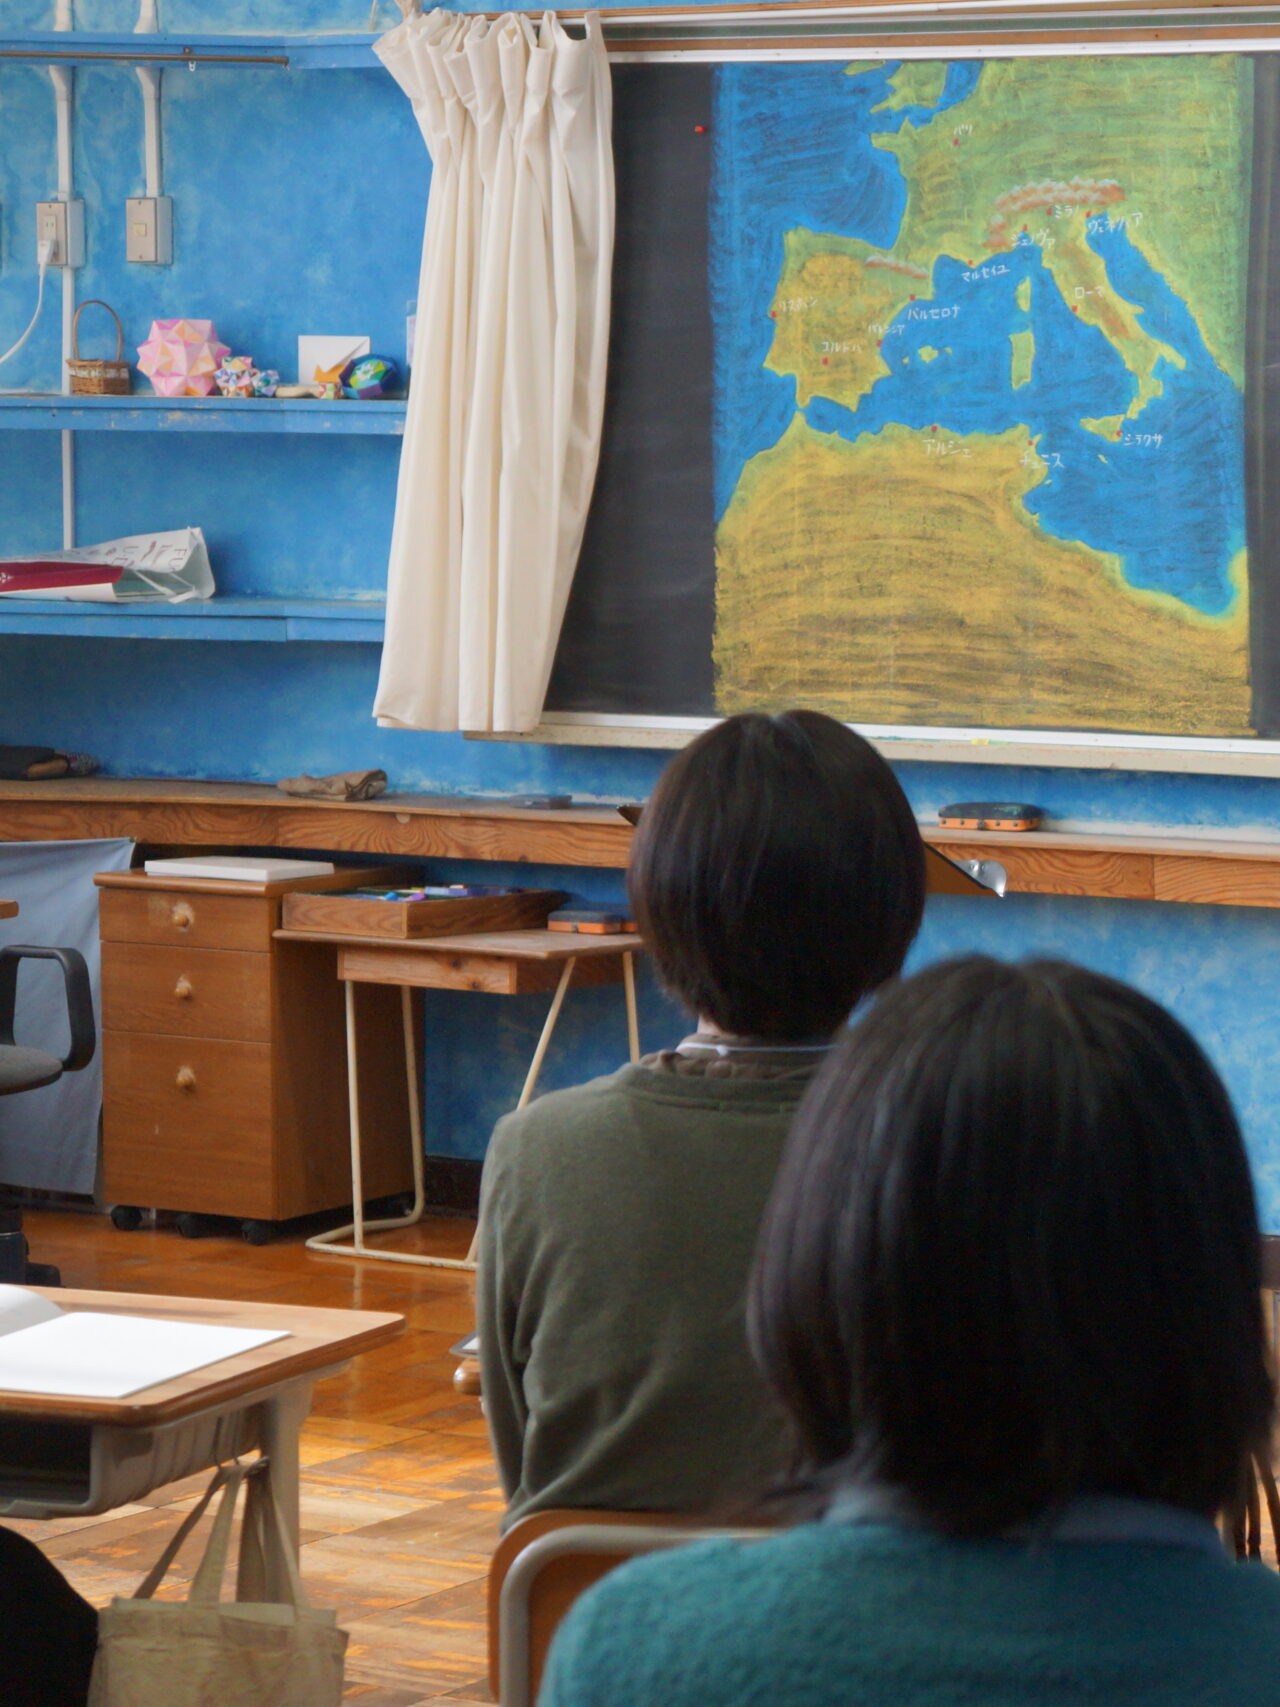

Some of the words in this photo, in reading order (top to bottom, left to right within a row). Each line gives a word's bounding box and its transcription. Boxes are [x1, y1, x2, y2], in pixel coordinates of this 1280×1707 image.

[1054, 204, 1080, 219] ミラノ
[961, 264, 1010, 282] マルセイユ
[1074, 285, 1106, 300] ローマ
[907, 304, 961, 321] バルセロナ
